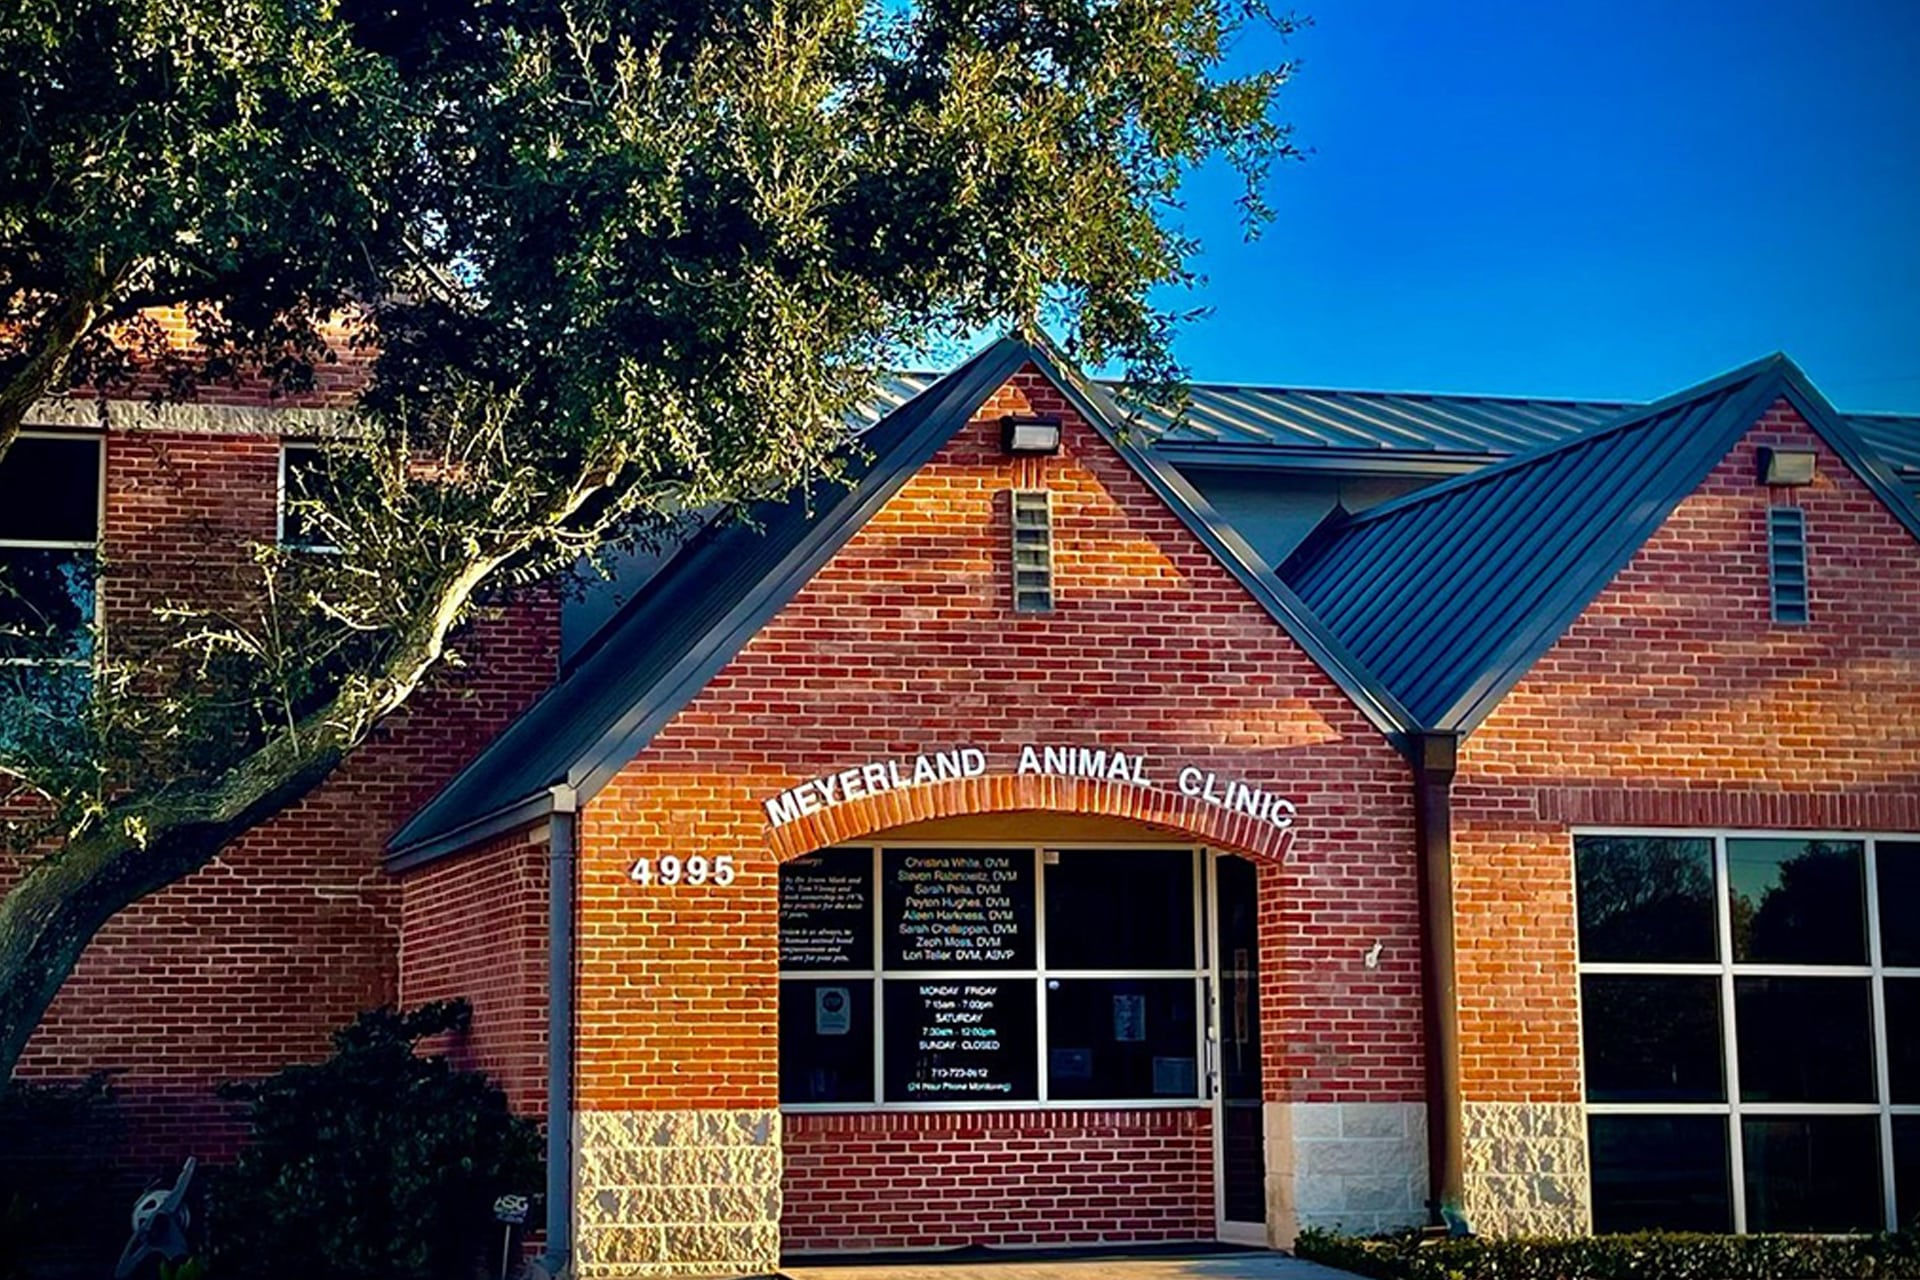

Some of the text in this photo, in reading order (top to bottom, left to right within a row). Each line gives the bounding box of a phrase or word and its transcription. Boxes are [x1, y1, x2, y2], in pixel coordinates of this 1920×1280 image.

[764, 746, 1296, 828] MEYERLAND ANIMAL CLINIC
[984, 857, 1009, 868] DVM
[630, 855, 735, 886] 4995
[992, 870, 1018, 881] DVM
[914, 884, 945, 895] Sarah
[976, 884, 1001, 895] DVM
[985, 896, 1010, 908] DVM
[988, 910, 1013, 921] DVM
[899, 923, 930, 935] Sarah
[992, 923, 1018, 935] DVM
[976, 936, 1001, 948] DVM
[919, 985, 998, 996] MONDAY FRIDAY
[935, 1012, 983, 1024] SATURDAY
[919, 1040, 957, 1050] SUNDAY
[961, 1040, 1001, 1050] CLOSED
